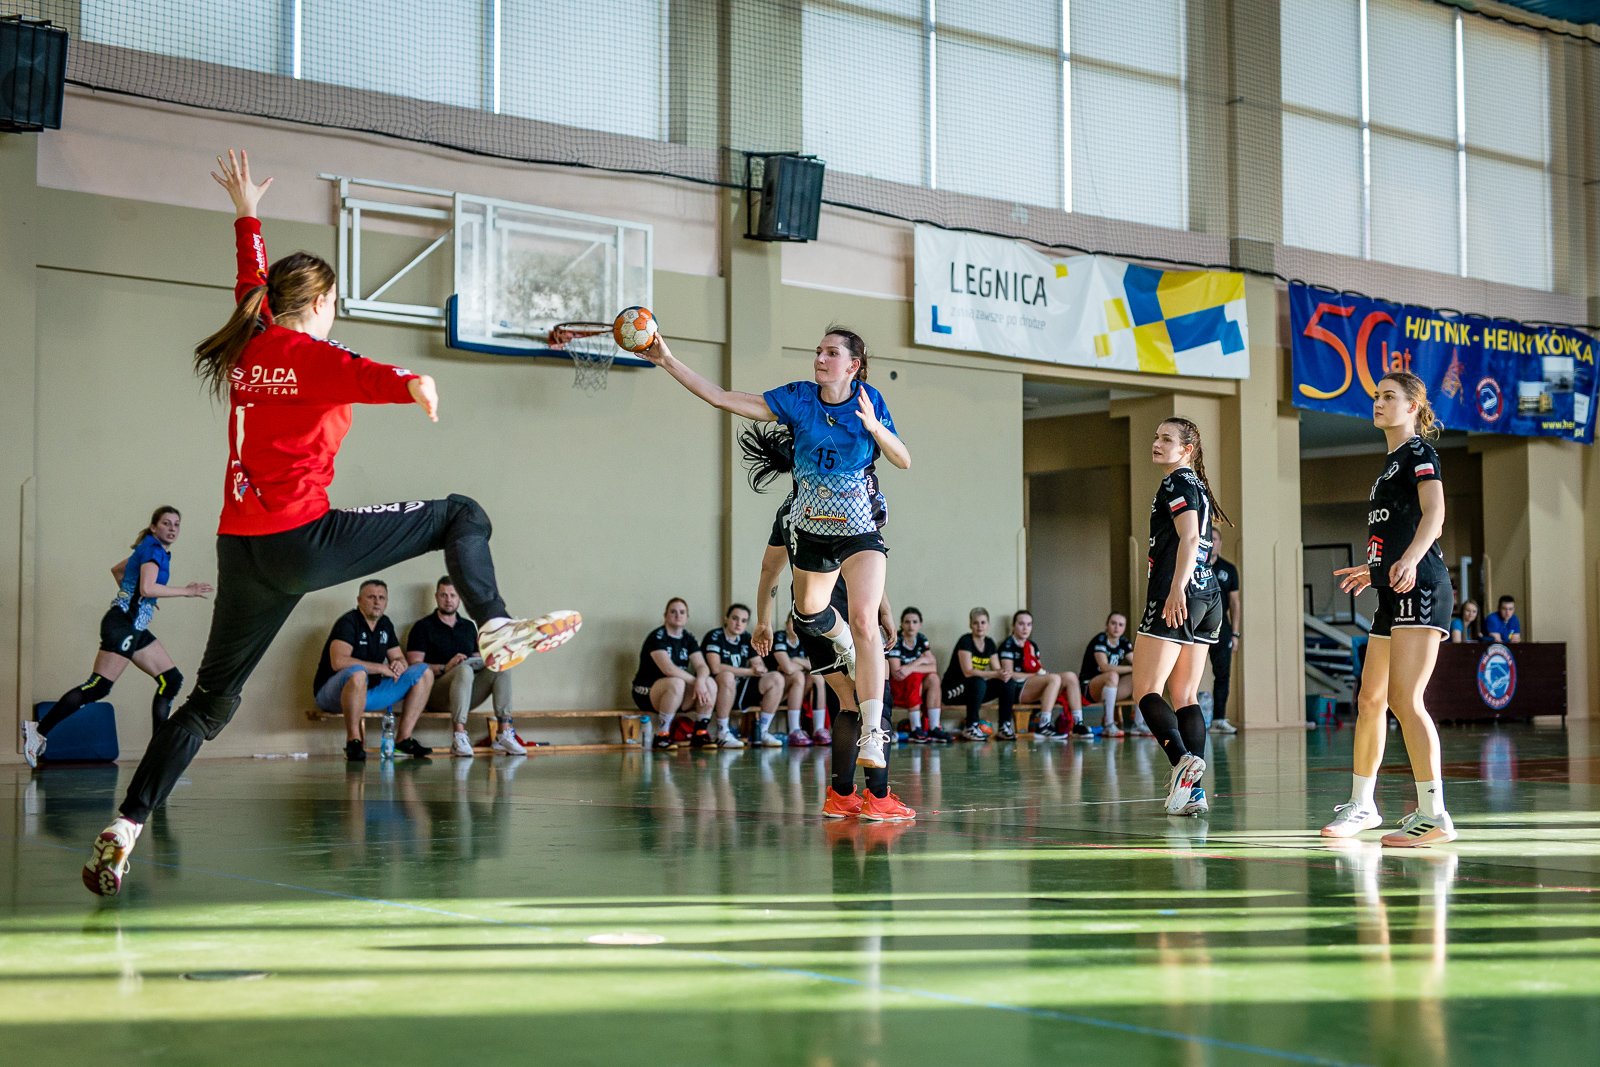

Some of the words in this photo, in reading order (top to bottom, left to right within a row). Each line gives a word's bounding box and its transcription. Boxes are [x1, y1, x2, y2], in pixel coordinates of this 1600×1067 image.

[949, 261, 1048, 308] LEGNICA
[1381, 340, 1412, 374] lat
[266, 387, 299, 395] TEAM
[815, 447, 838, 471] 15
[1399, 598, 1412, 617] 11
[121, 635, 133, 651] 6
